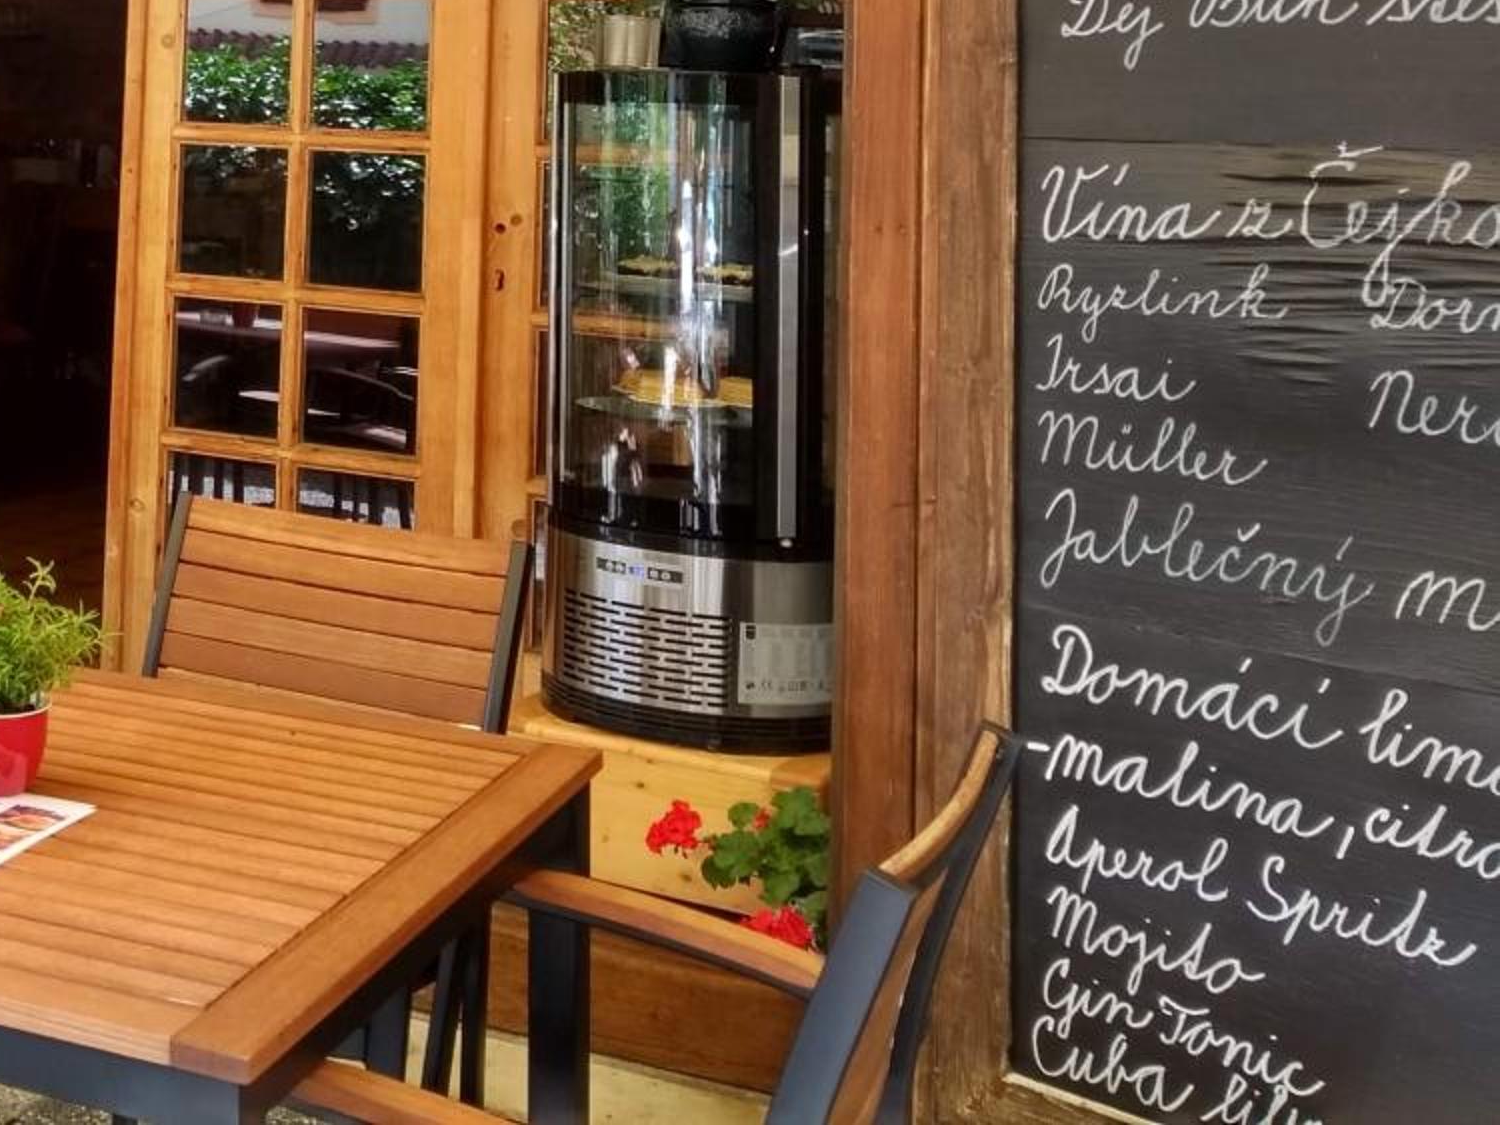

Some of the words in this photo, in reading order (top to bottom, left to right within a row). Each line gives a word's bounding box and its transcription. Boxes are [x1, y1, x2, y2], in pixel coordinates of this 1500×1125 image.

[1042, 164, 1221, 243] Vína
[1038, 263, 1289, 342] Ryzlink
[1038, 411, 1268, 485] Müller
[1369, 370, 1500, 444] Ner
[1041, 488, 1374, 647] Jablečný
[1041, 623, 1343, 749] Domácí
[1045, 805, 1228, 902] Aperol
[1047, 886, 1266, 996] Mojito
[1032, 1016, 1195, 1112] Cuba
[1043, 958, 1154, 1039] Gin
[1159, 994, 1326, 1096] Tonic
